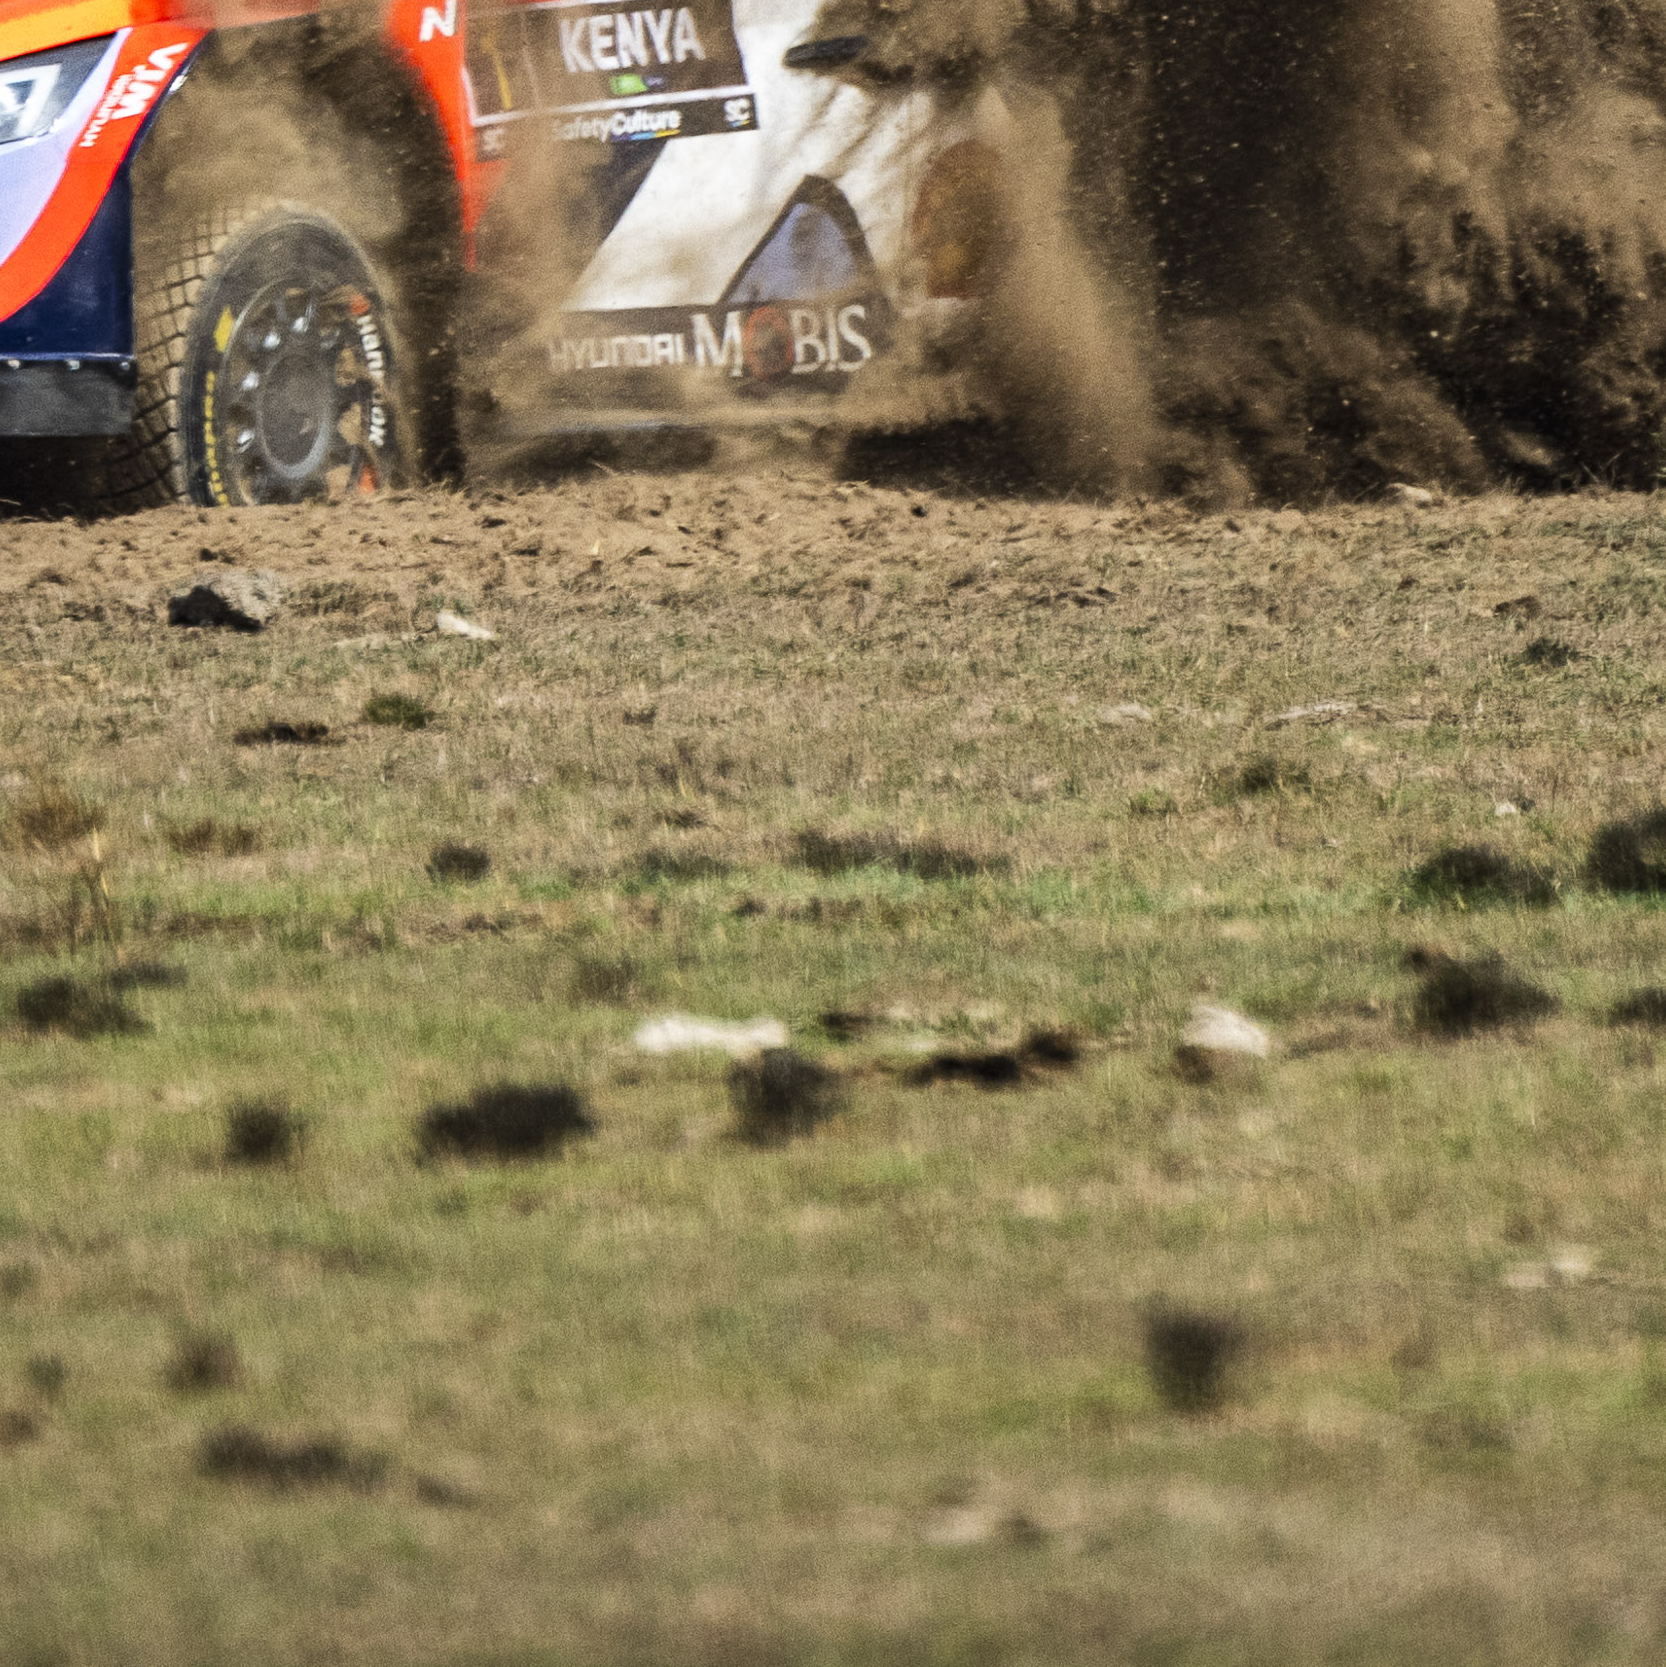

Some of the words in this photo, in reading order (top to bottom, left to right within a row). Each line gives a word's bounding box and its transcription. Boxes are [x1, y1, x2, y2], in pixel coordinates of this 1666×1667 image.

[559, 7, 707, 73] KENYA
[724, 98, 750, 122] SC
[691, 305, 872, 379] MOBIS
